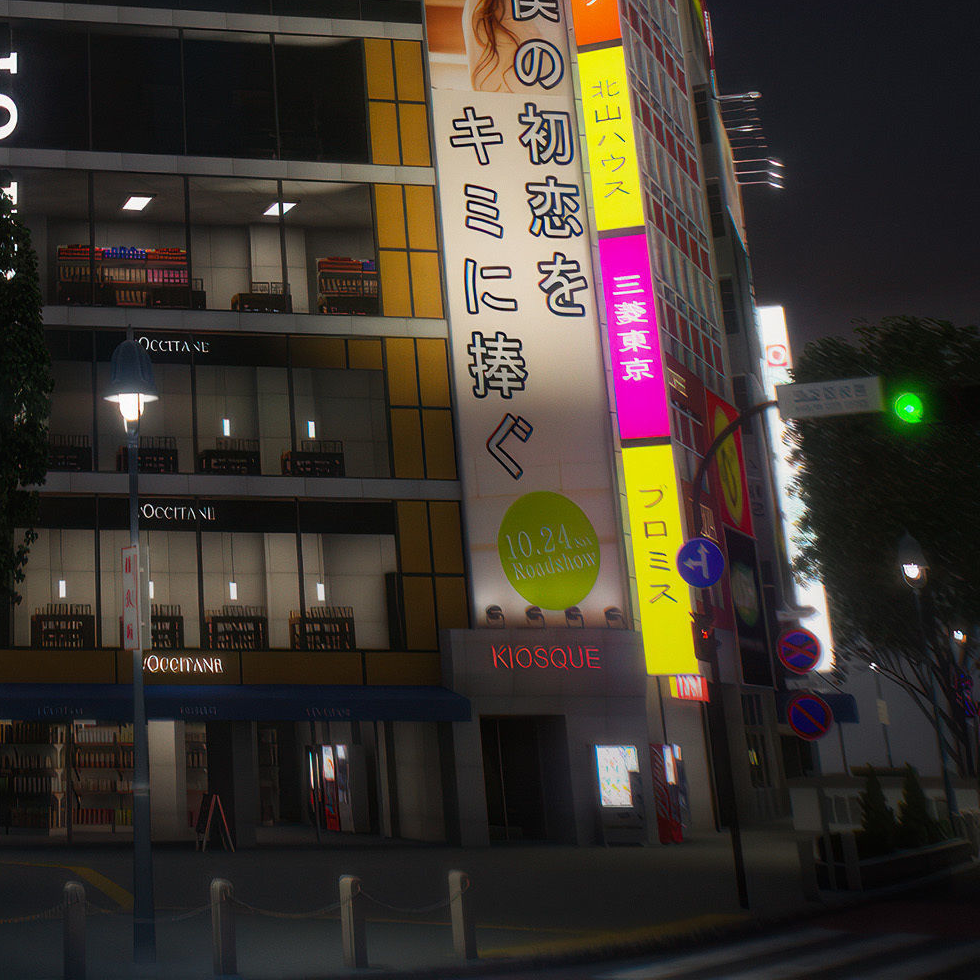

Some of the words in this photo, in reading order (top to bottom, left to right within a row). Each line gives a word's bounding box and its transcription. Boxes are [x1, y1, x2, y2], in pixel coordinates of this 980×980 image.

[591, 79, 631, 198] 北山ハウス
[449, 106, 535, 480] キミに捧ぐ
[612, 274, 655, 382] 三菱東京
[511, 552, 597, 581] Roadshow
[491, 644, 602, 671] KIOSQUE
